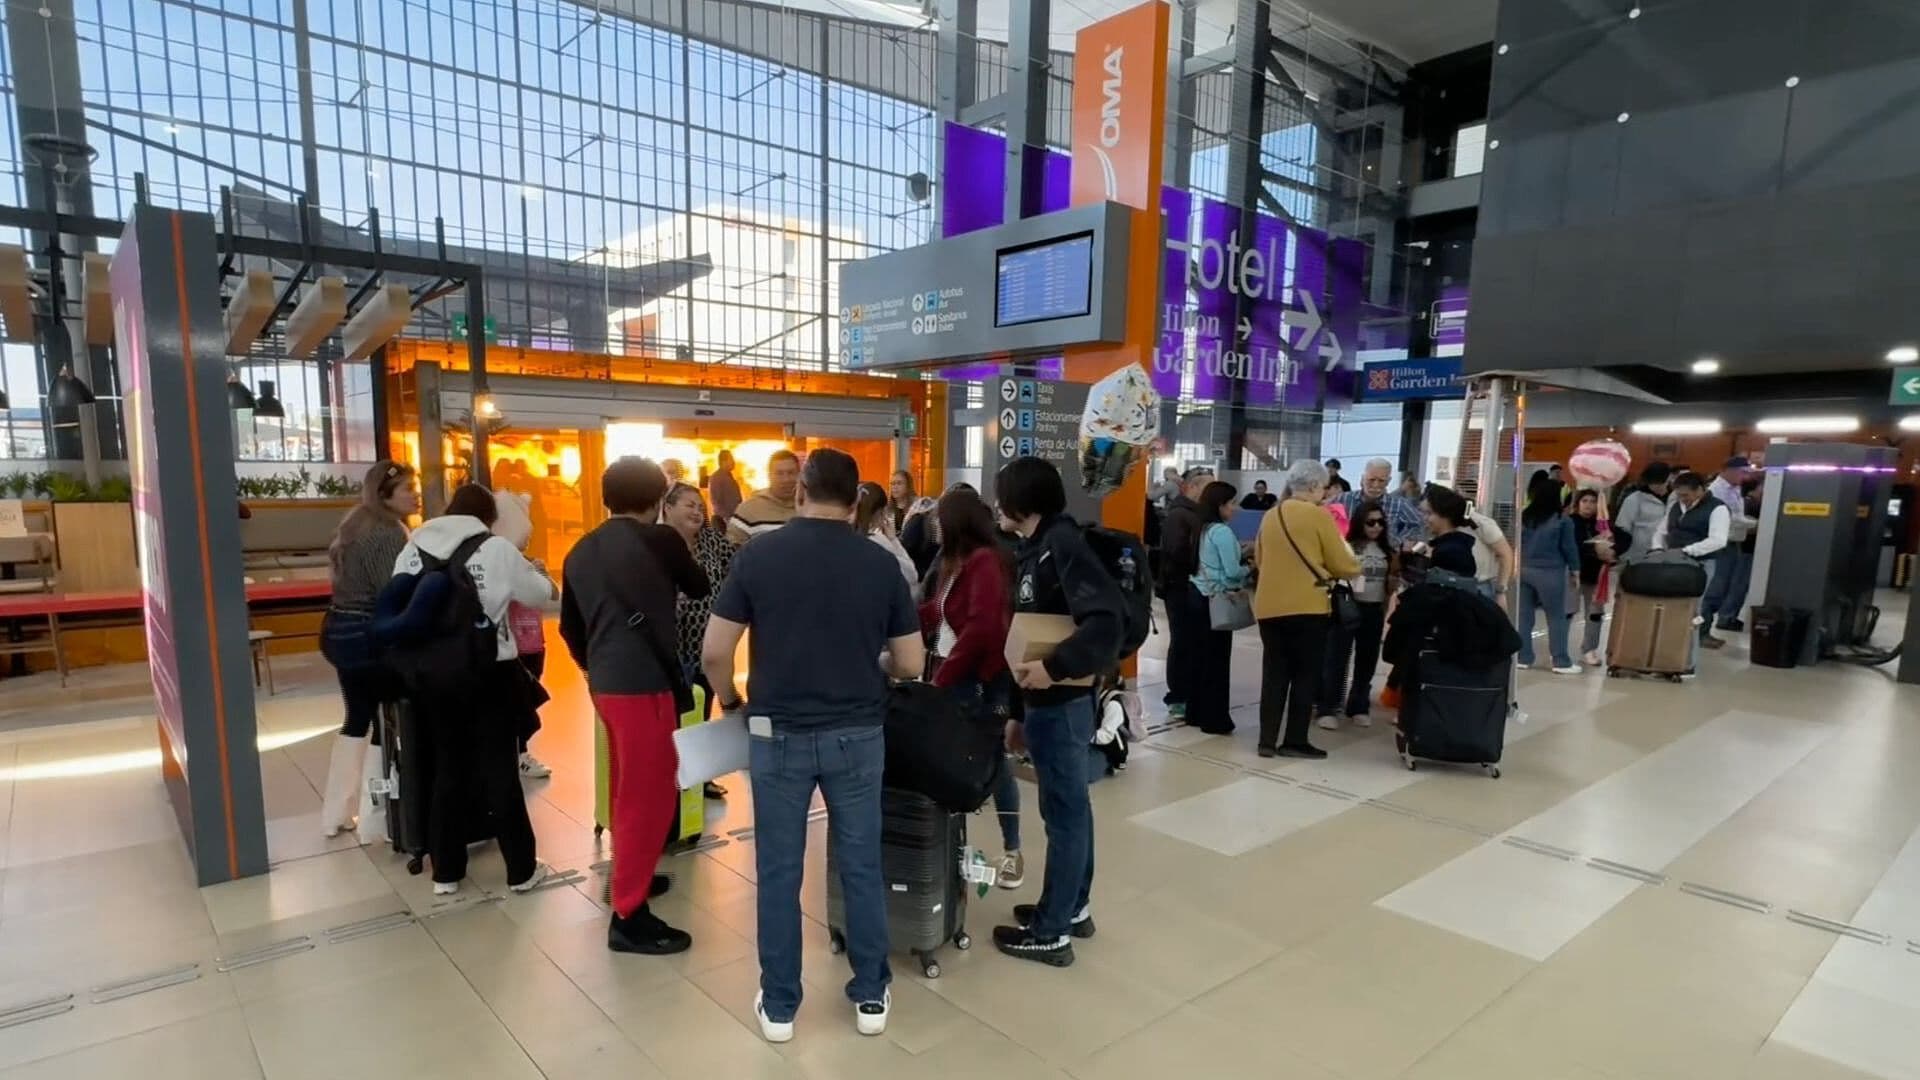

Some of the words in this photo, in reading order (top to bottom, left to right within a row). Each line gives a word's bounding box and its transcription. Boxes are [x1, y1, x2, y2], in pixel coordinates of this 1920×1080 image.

[1100, 45, 1124, 148] OMA
[1162, 209, 1277, 301] Hotel
[1154, 334, 1254, 380] Garden
[1258, 347, 1300, 385] Inn
[1391, 367, 1426, 377] Hilton
[1037, 382, 1055, 394] Taxis
[1389, 375, 1447, 390] Garden
[1034, 437, 1055, 450] Renta
[1055, 439, 1065, 450] de
